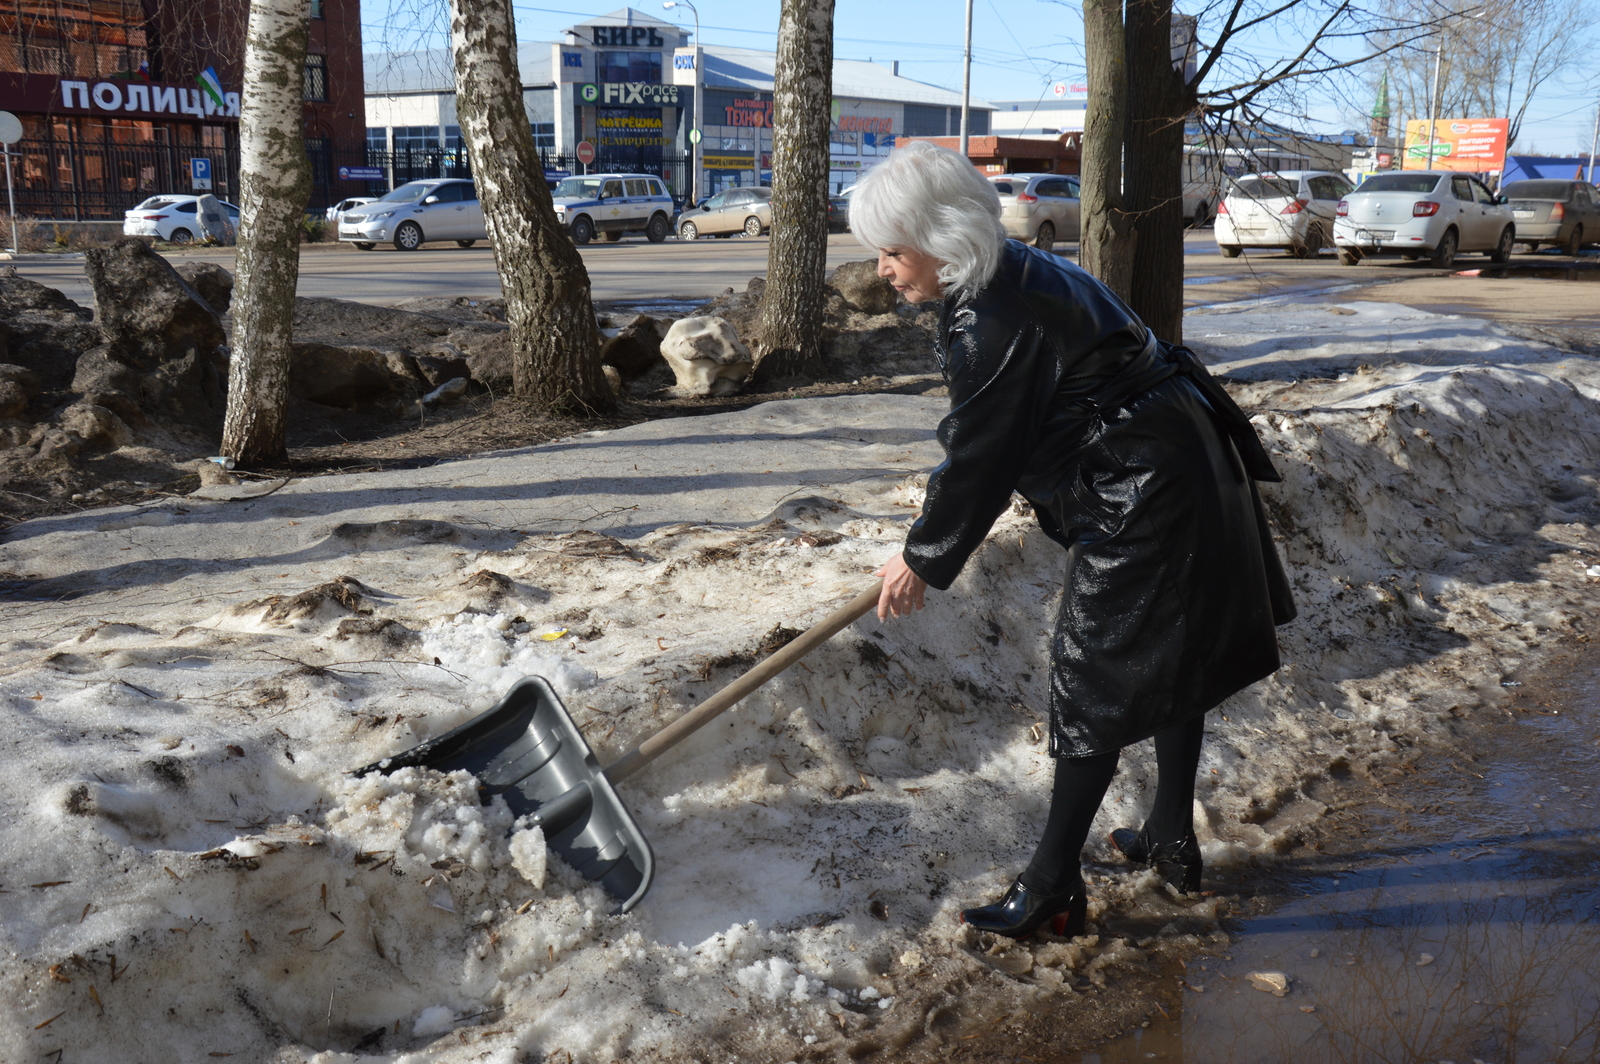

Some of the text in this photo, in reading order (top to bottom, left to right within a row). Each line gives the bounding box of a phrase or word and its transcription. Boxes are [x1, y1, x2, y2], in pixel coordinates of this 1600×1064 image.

[592, 26, 663, 47] БИРЬ
[563, 52, 582, 67] ТСК
[674, 55, 695, 69] ССК
[643, 85, 678, 98] price
[61, 80, 240, 118] ПОЛИЦИЯ
[734, 99, 765, 109] БЫТОВАЯ
[597, 116, 662, 128] МАТРЁШКА
[725, 106, 774, 128] ТЕХНОС
[1457, 144, 1490, 152] РЕШЕНИЕ
[1458, 137, 1496, 145] ВЫГОДНОЕ
[196, 161, 206, 177] P
